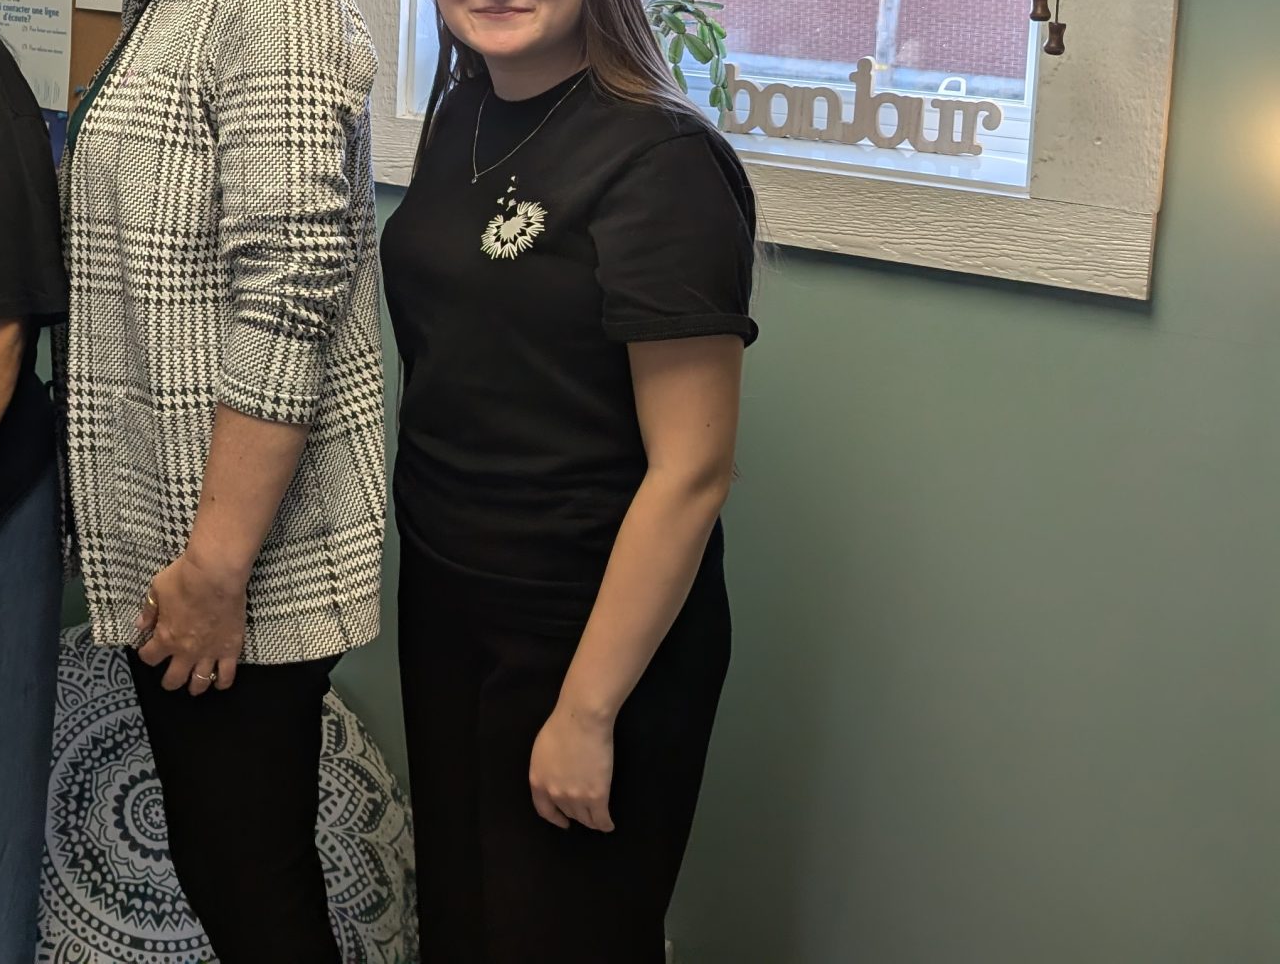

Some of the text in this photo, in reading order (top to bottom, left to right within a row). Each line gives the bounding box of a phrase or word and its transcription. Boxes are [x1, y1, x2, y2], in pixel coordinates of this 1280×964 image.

[2, 4, 30, 14] contacter
[31, 7, 43, 15] une
[44, 6, 59, 18] ligne
[3, 13, 31, 23] d'écoute?
[723, 57, 1003, 156] bonjour
